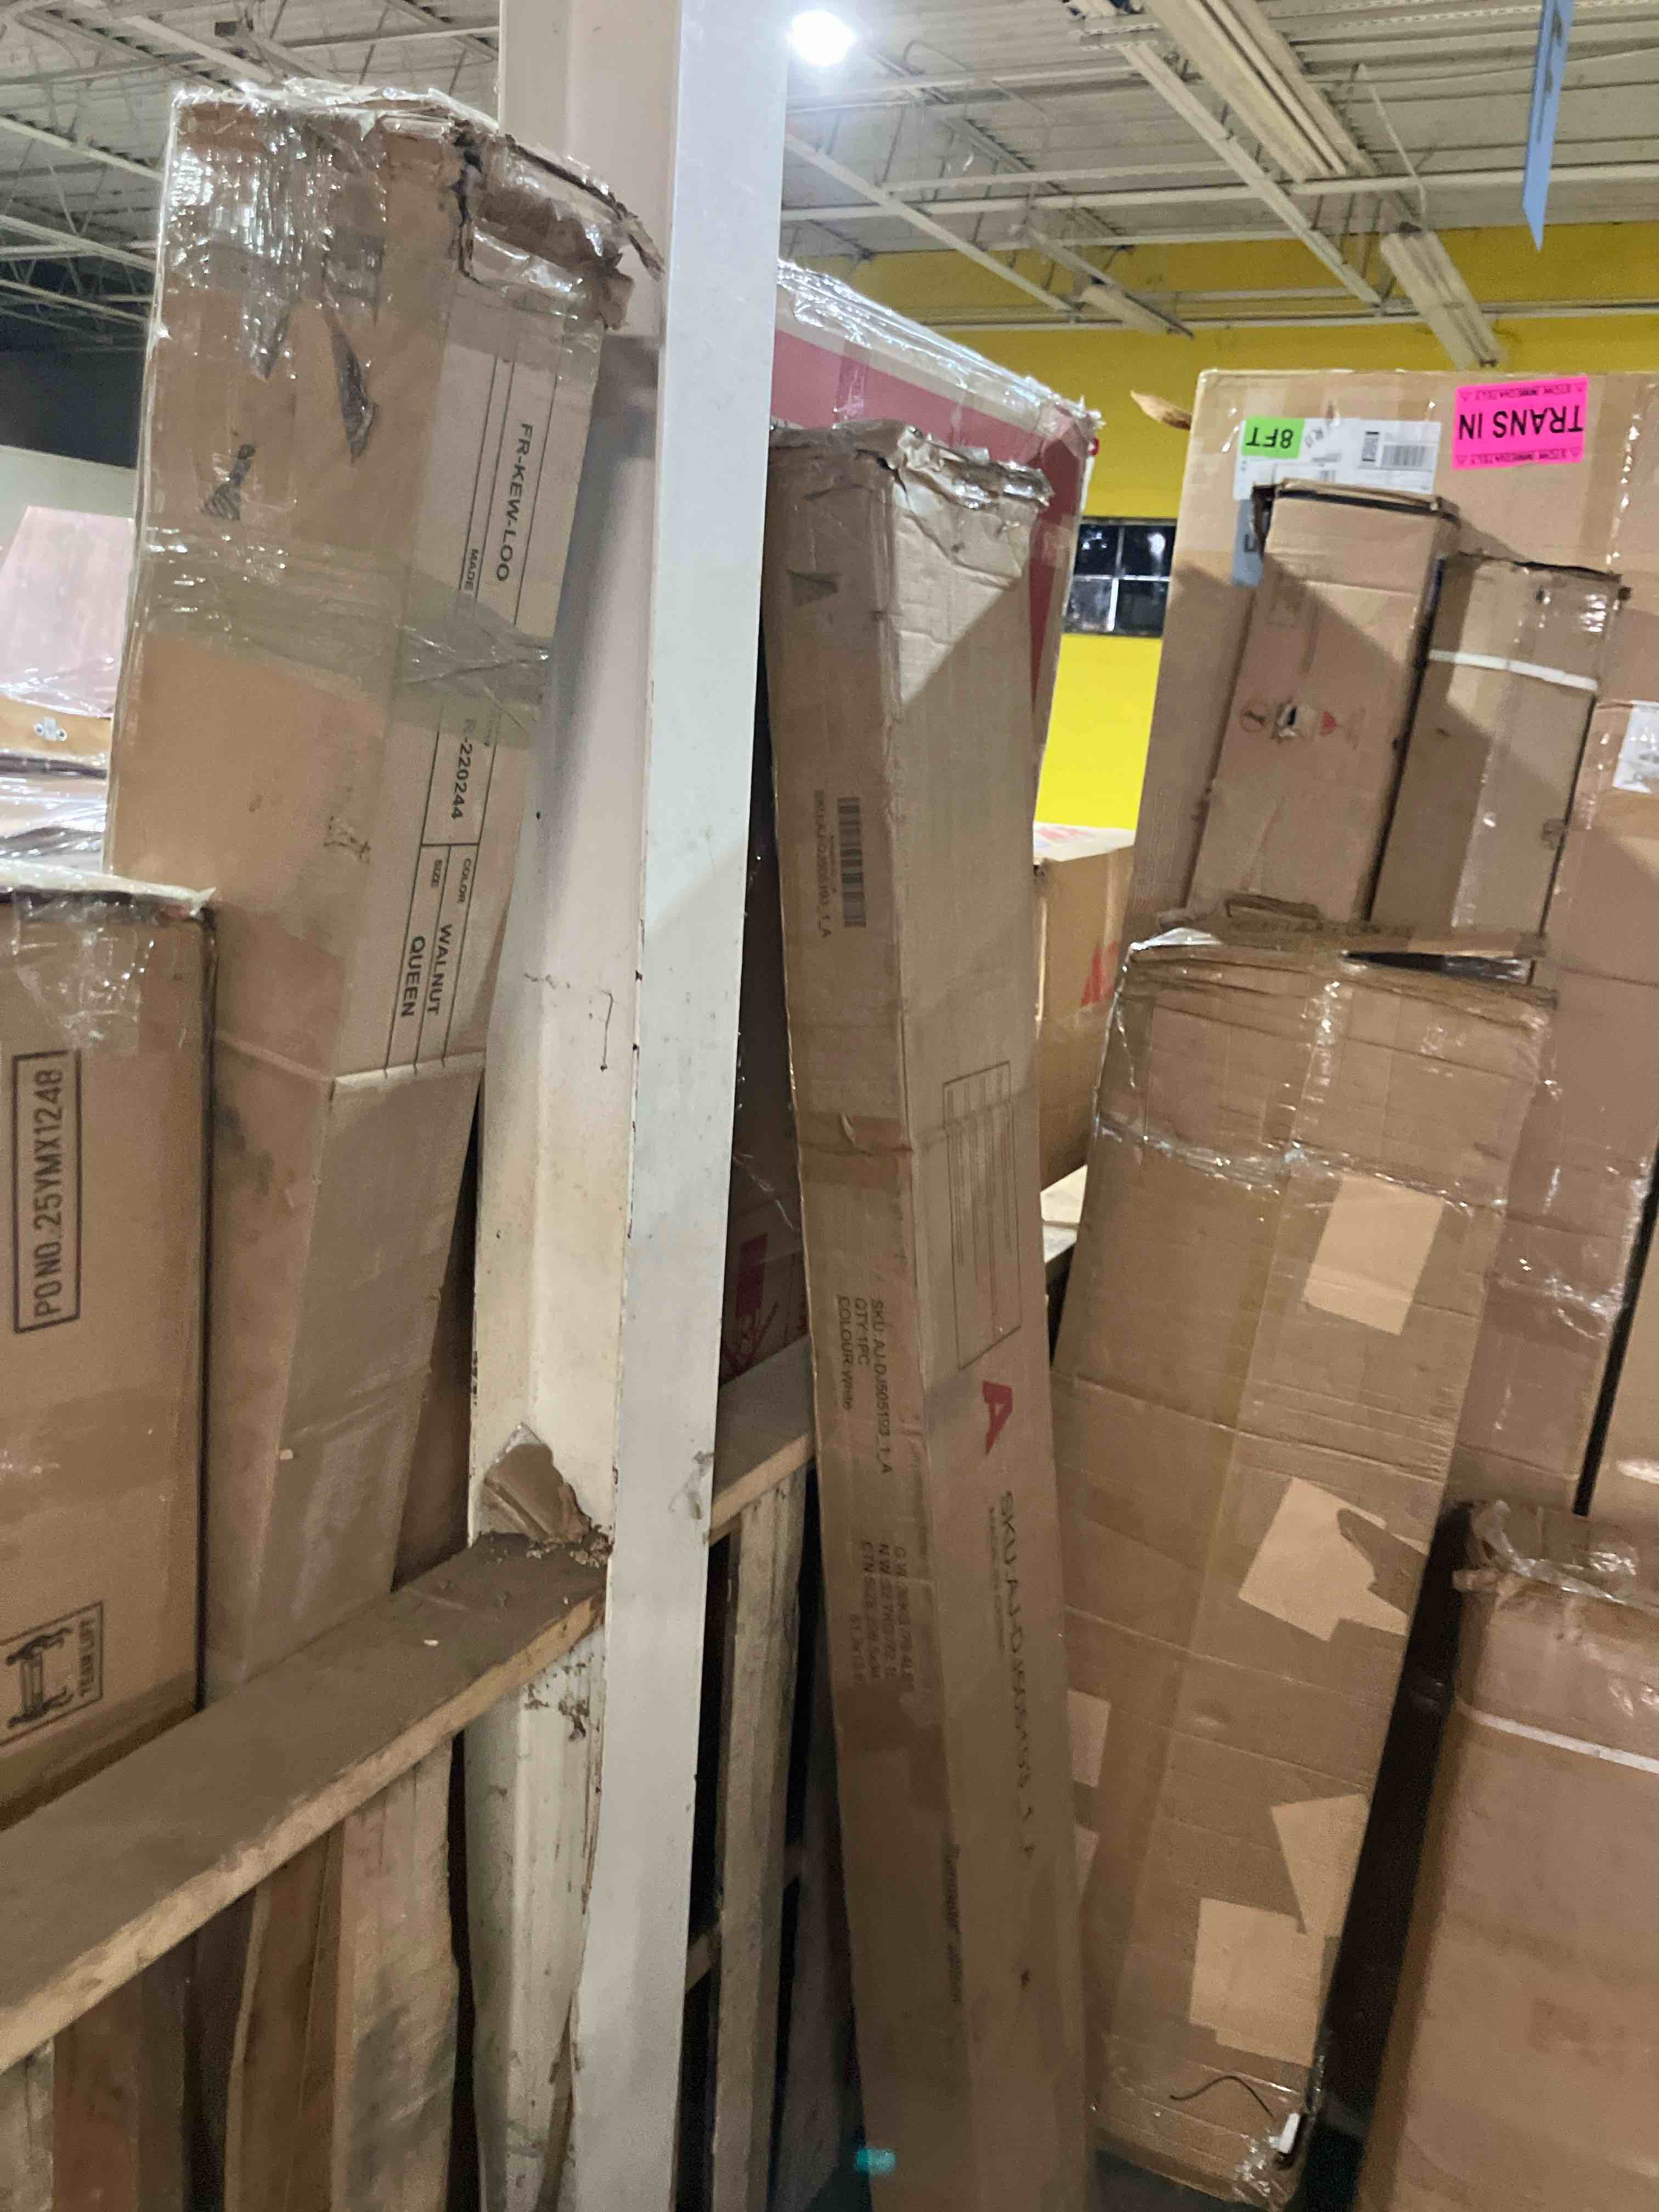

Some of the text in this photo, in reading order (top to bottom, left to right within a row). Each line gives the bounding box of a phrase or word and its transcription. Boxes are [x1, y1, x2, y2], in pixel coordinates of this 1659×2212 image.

[1245, 427, 1294, 449] 8FT
[1458, 404, 1584, 441] TRANS IN
[496, 422, 533, 582] FR-KEW-LOO
[431, 859, 444, 888] SIZE
[457, 858, 472, 905] COLOR
[400, 935, 426, 1017] QUEEN
[426, 924, 453, 1015] WALNUT
